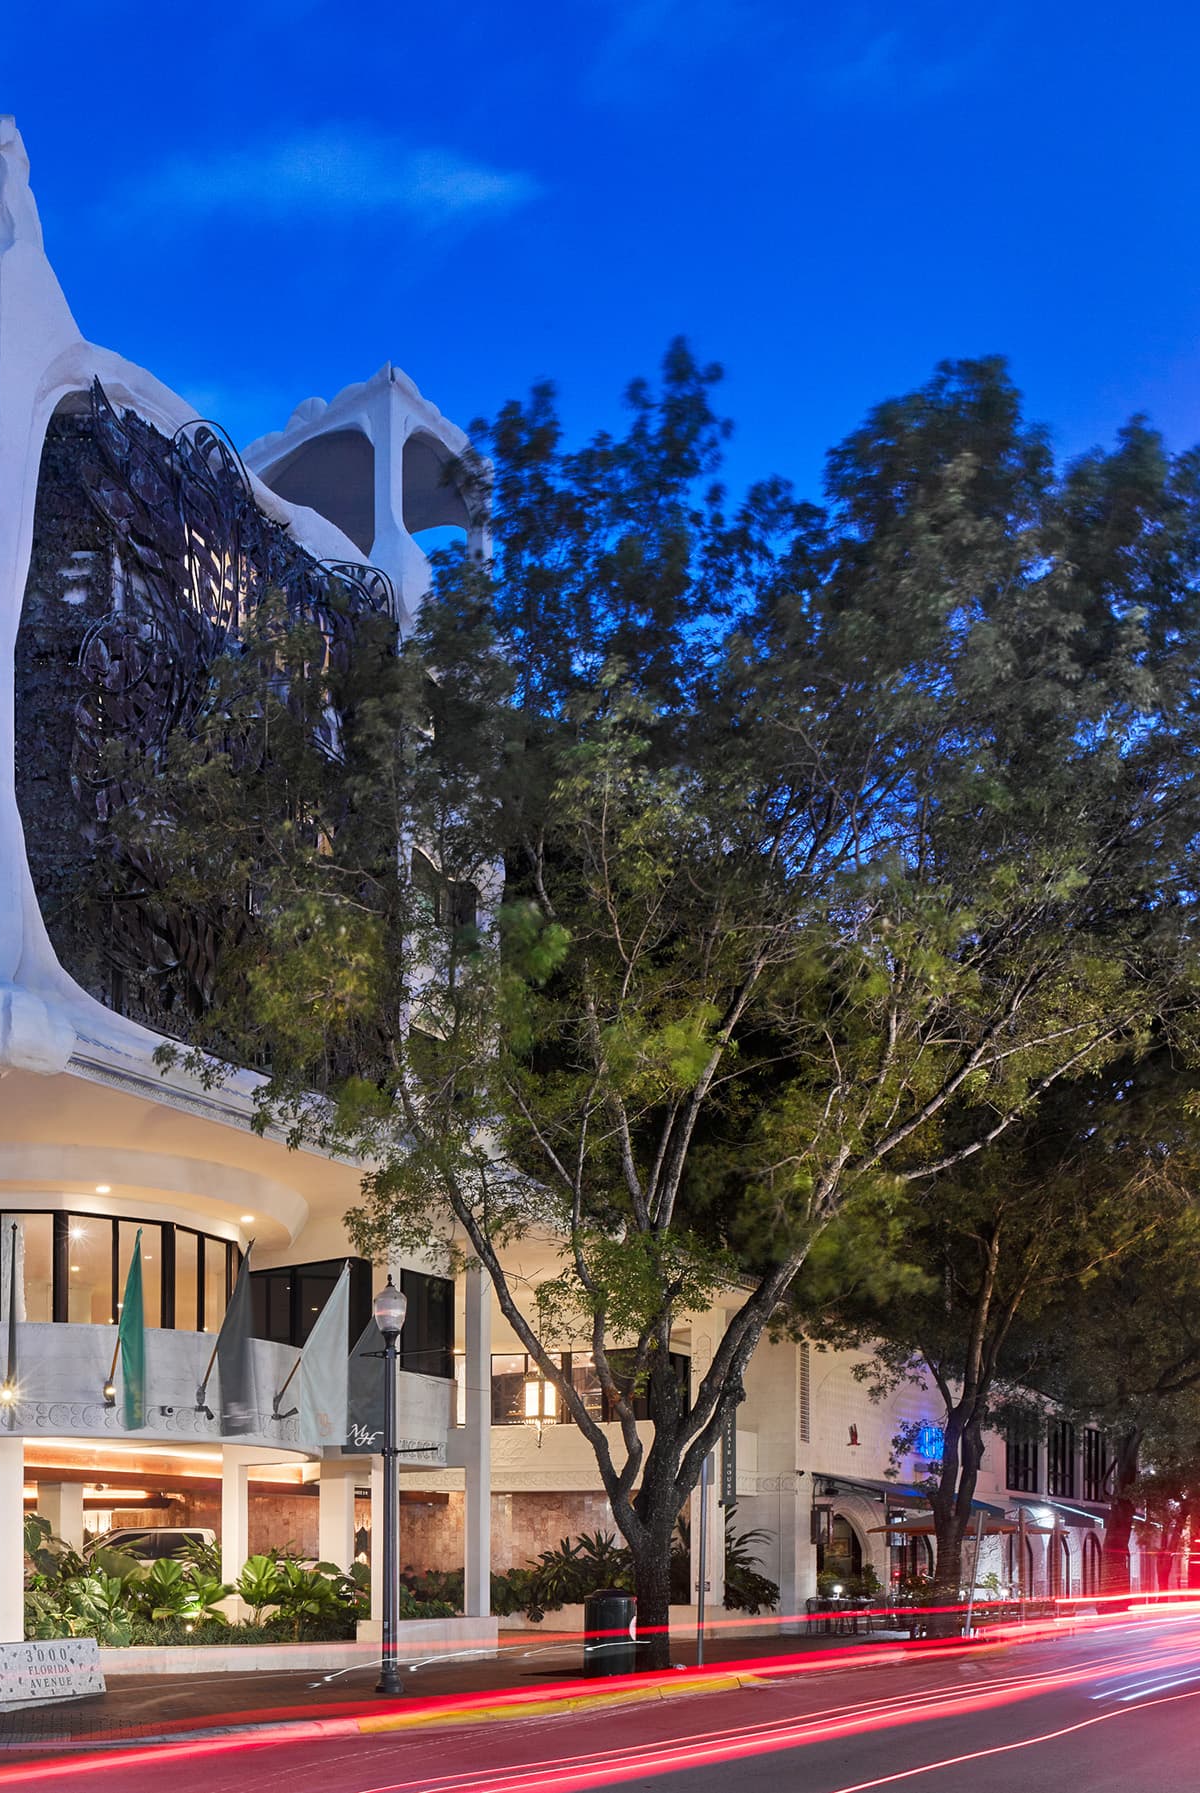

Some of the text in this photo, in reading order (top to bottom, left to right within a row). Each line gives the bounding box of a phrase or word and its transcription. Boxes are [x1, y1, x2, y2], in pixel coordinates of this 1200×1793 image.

[726, 1463, 734, 1496] HOUSE
[25, 1647, 67, 1663] 3000
[28, 1663, 70, 1675] FLORIDA
[30, 1676, 73, 1689] AVENUE
